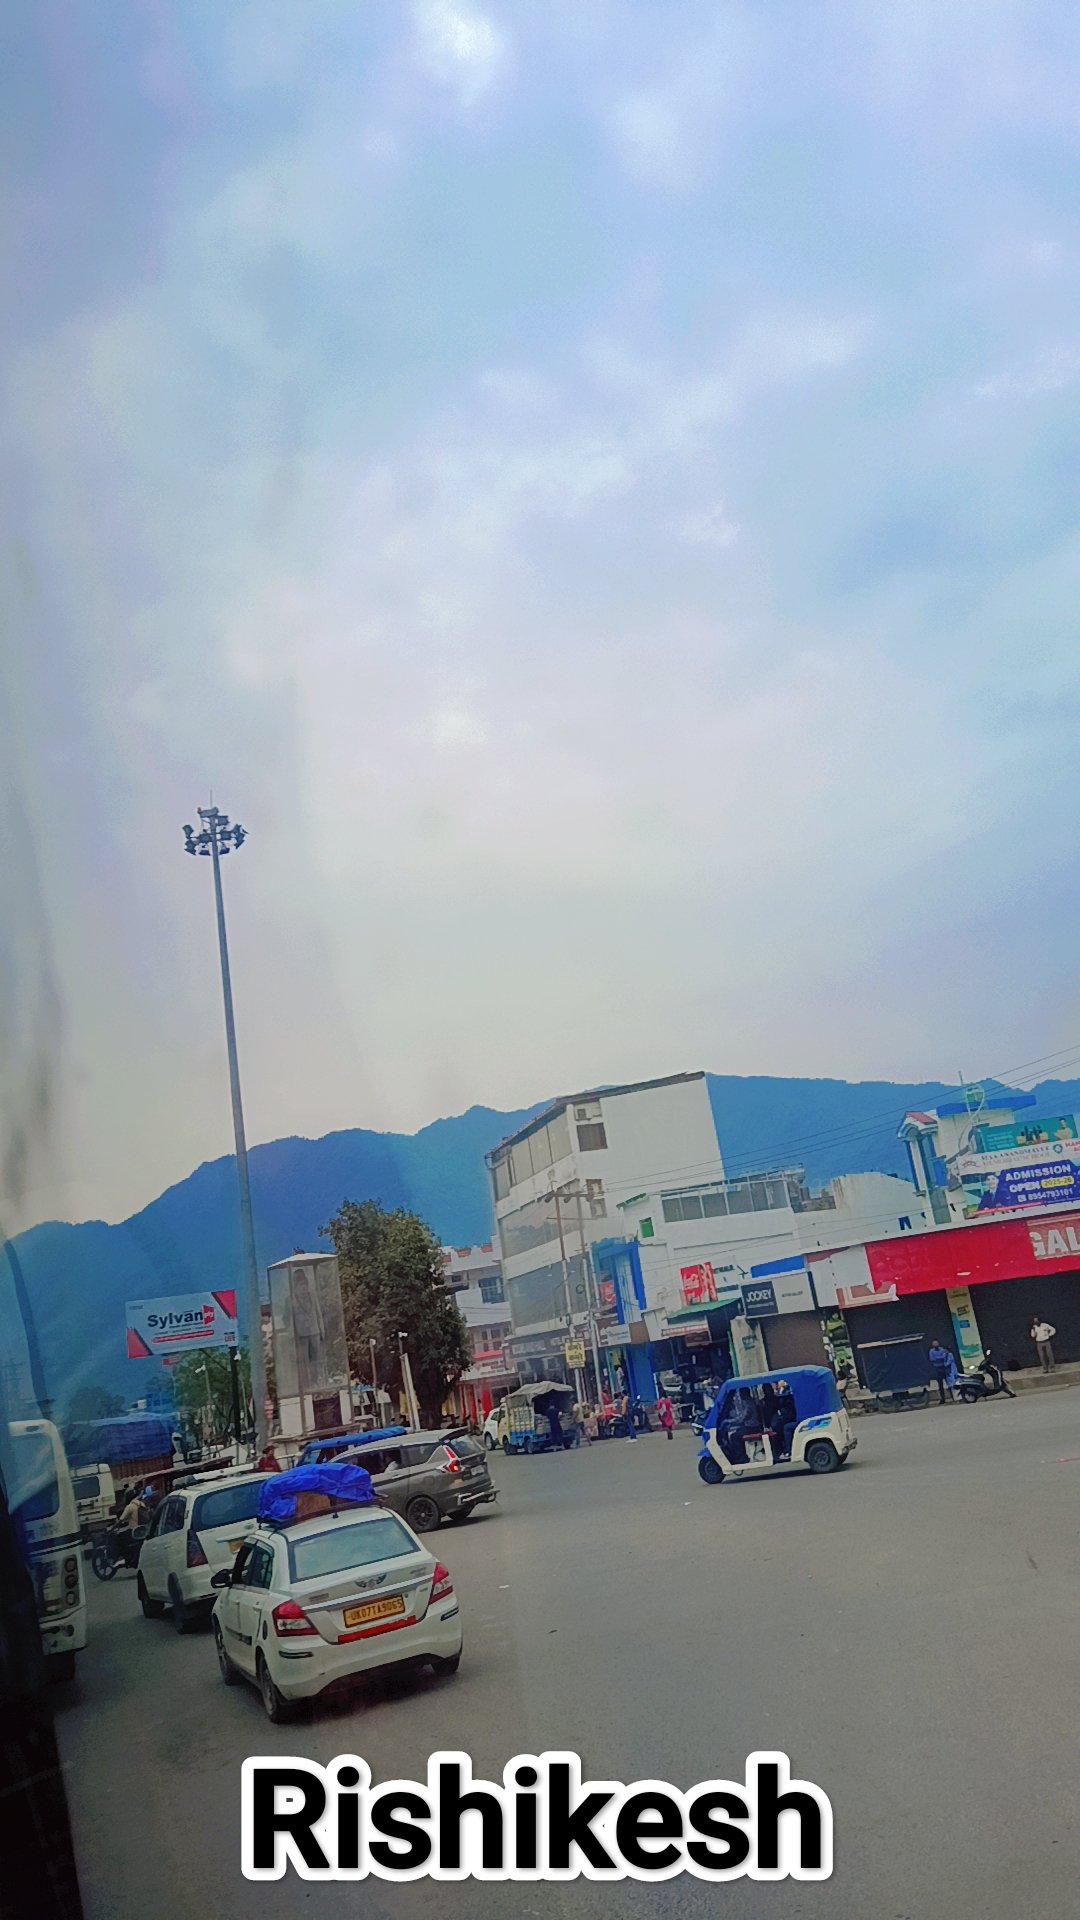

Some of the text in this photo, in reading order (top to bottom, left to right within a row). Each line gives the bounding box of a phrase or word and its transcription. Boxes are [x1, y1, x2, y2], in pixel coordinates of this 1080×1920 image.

[1005, 1164, 1071, 1182] ADMISSION
[1009, 1181, 1040, 1193] OPEN
[746, 1289, 772, 1303] JOCKEY
